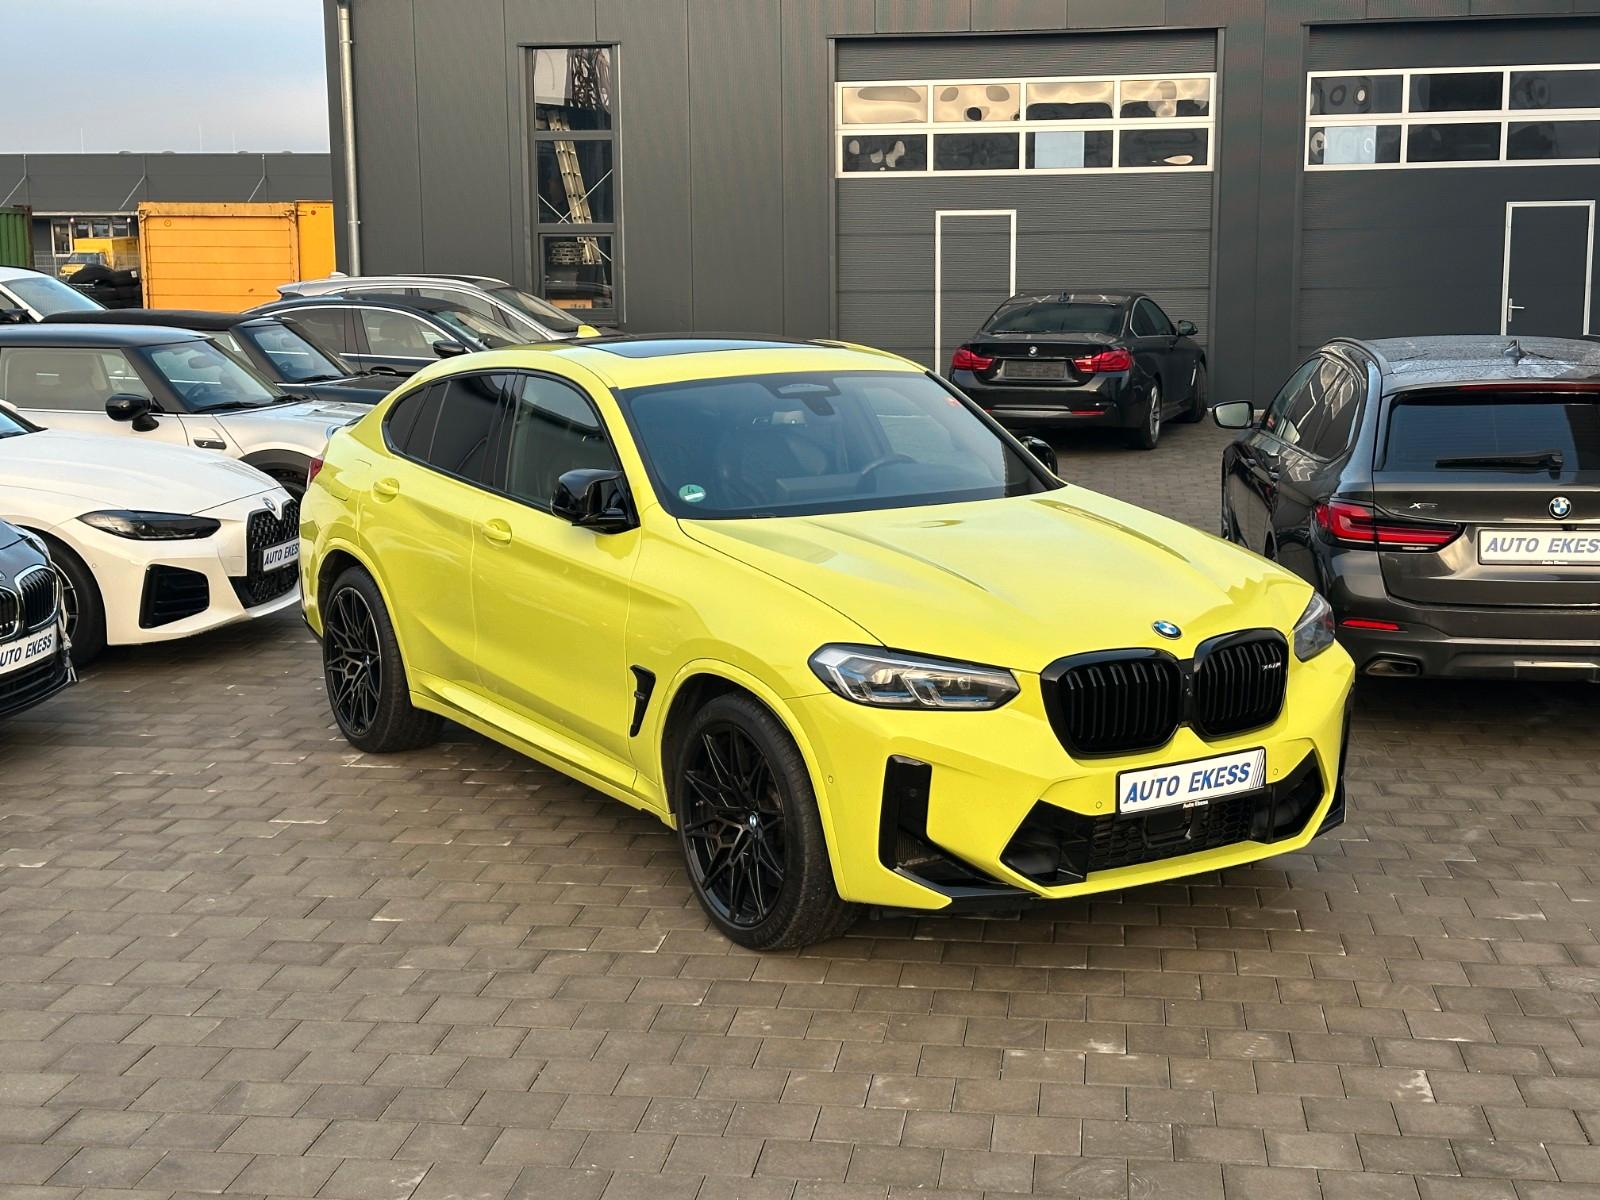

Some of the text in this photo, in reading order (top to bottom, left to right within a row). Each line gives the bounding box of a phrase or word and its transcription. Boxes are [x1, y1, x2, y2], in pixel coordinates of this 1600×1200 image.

[1485, 537, 1600, 554] AUTO EKES
[264, 549, 282, 566] AUTO
[25, 633, 52, 658] EKESS
[1124, 762, 1251, 804] AUTO EKESS
